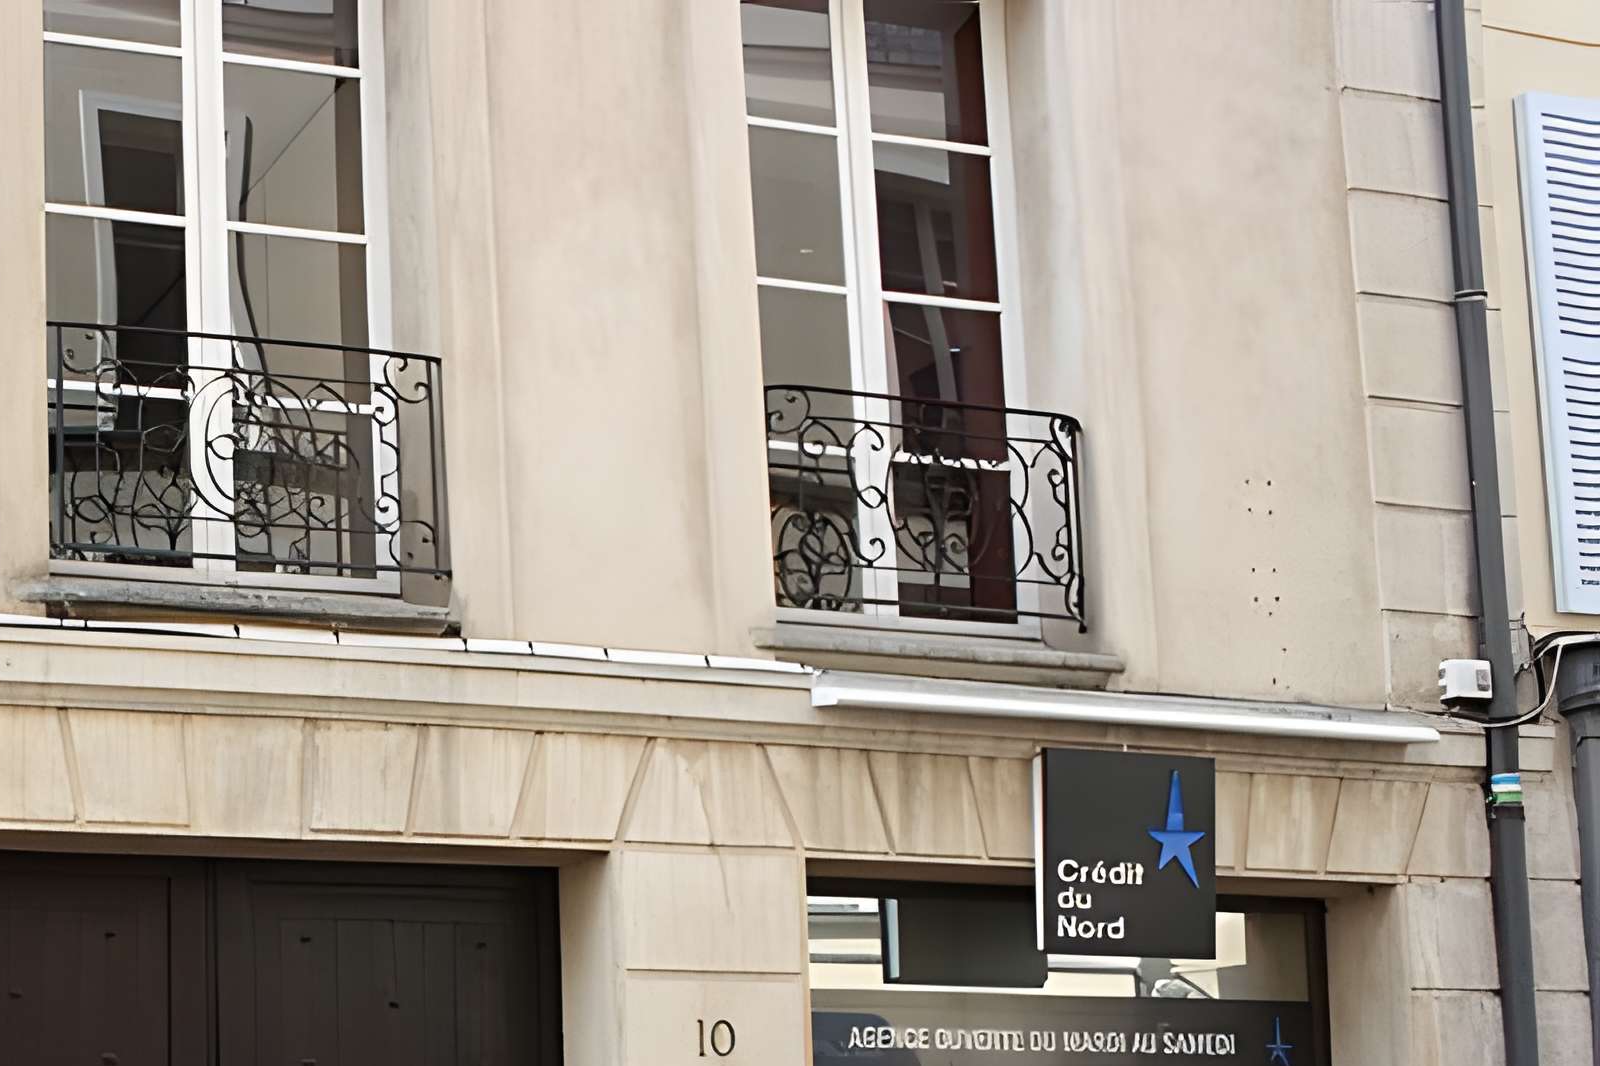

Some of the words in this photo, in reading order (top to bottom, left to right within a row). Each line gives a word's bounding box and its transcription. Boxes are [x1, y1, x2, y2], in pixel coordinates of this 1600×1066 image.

[1057, 859, 1144, 885] Crédit
[1057, 886, 1092, 910] du
[1057, 914, 1125, 940] Nord
[696, 1018, 736, 1057] 10
